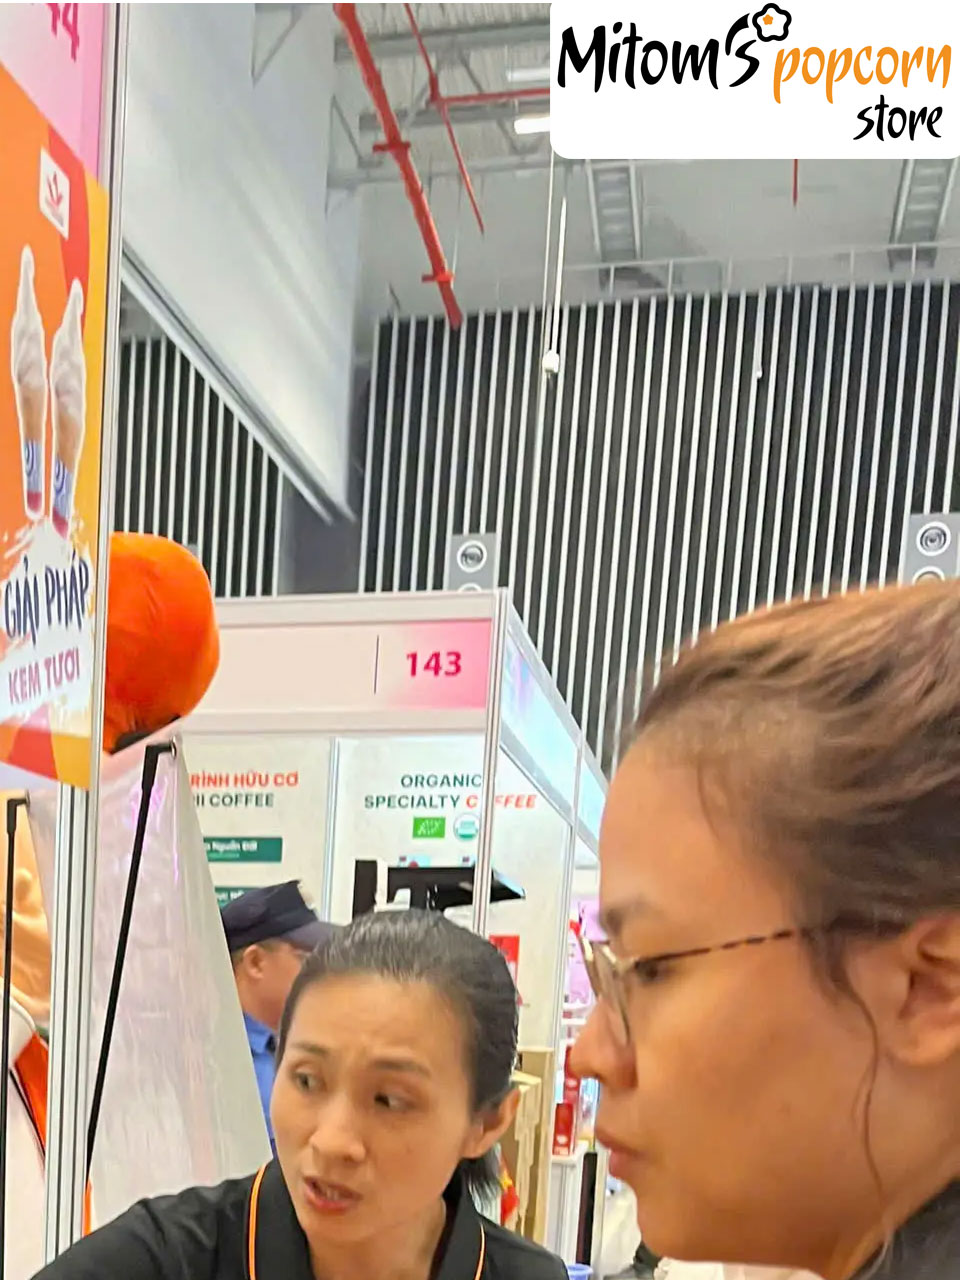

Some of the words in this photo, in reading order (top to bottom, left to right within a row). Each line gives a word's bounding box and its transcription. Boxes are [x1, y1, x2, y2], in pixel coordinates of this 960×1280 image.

[4, 556, 40, 646] GIẢI
[45, 550, 89, 632] PHÁP
[406, 651, 462, 677] 143
[8, 665, 42, 705] KEM
[401, 774, 482, 788] ORGANIC
[209, 793, 275, 807] COFFEE
[364, 794, 461, 809] SPECIALTY
[466, 794, 537, 809] CFFEE
